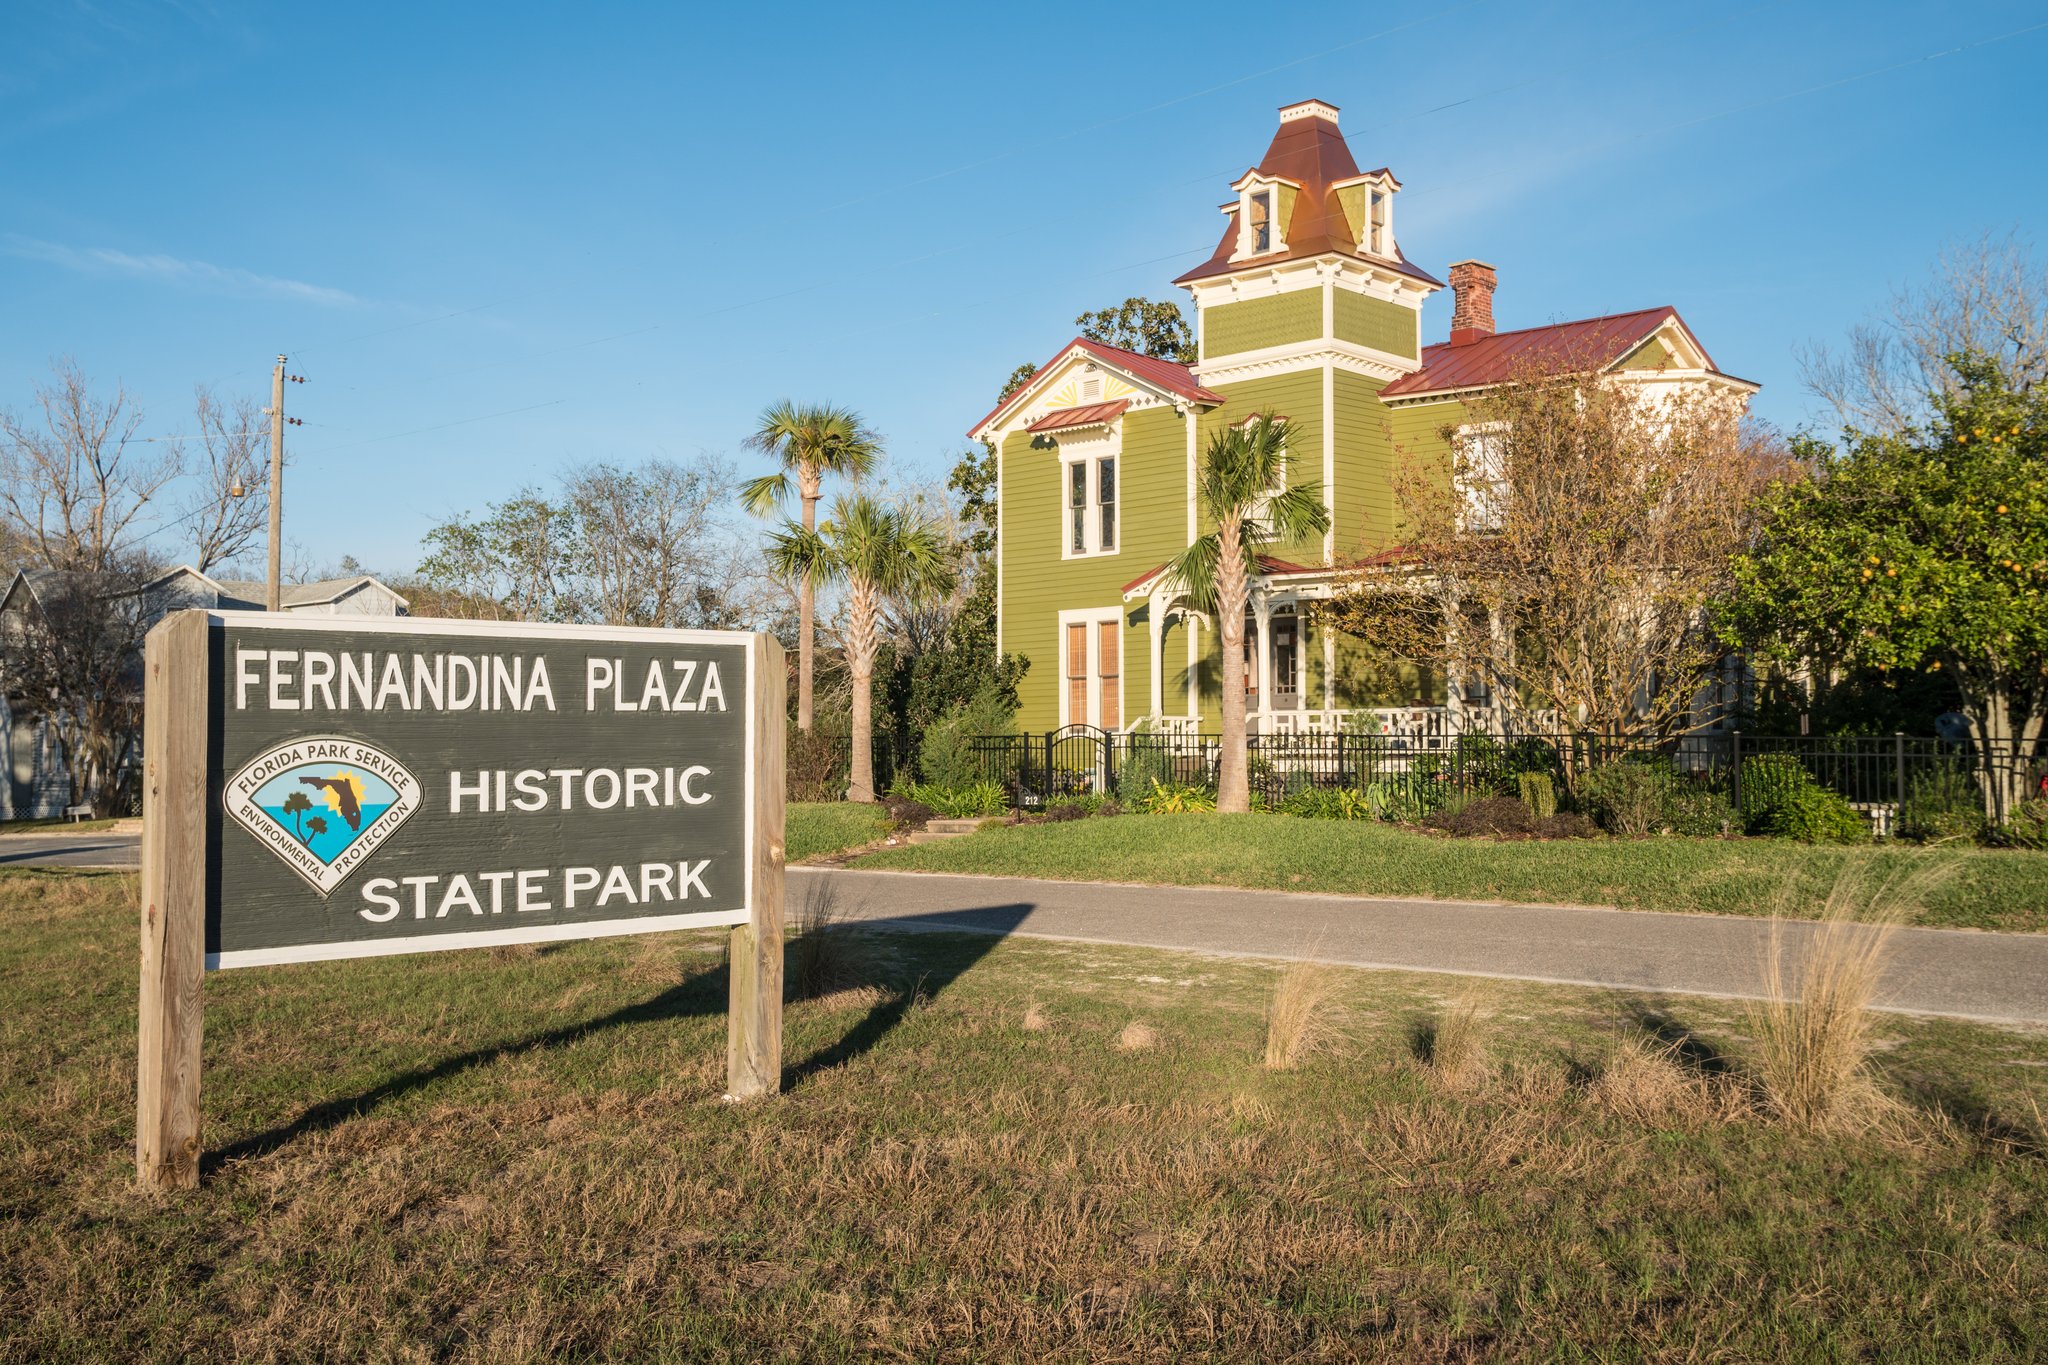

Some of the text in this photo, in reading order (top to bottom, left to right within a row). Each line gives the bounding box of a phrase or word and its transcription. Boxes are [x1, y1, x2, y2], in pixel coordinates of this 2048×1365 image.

[237, 650, 726, 711] FERNANDINA PLAZA
[238, 744, 410, 794] FLORIDA PARK SERVICE
[451, 766, 711, 812] HISTORIC
[1025, 796, 1038, 805] 212
[240, 802, 410, 881] ENVIRONMENTAL PROTECTION
[360, 860, 712, 923] STATE PARK
